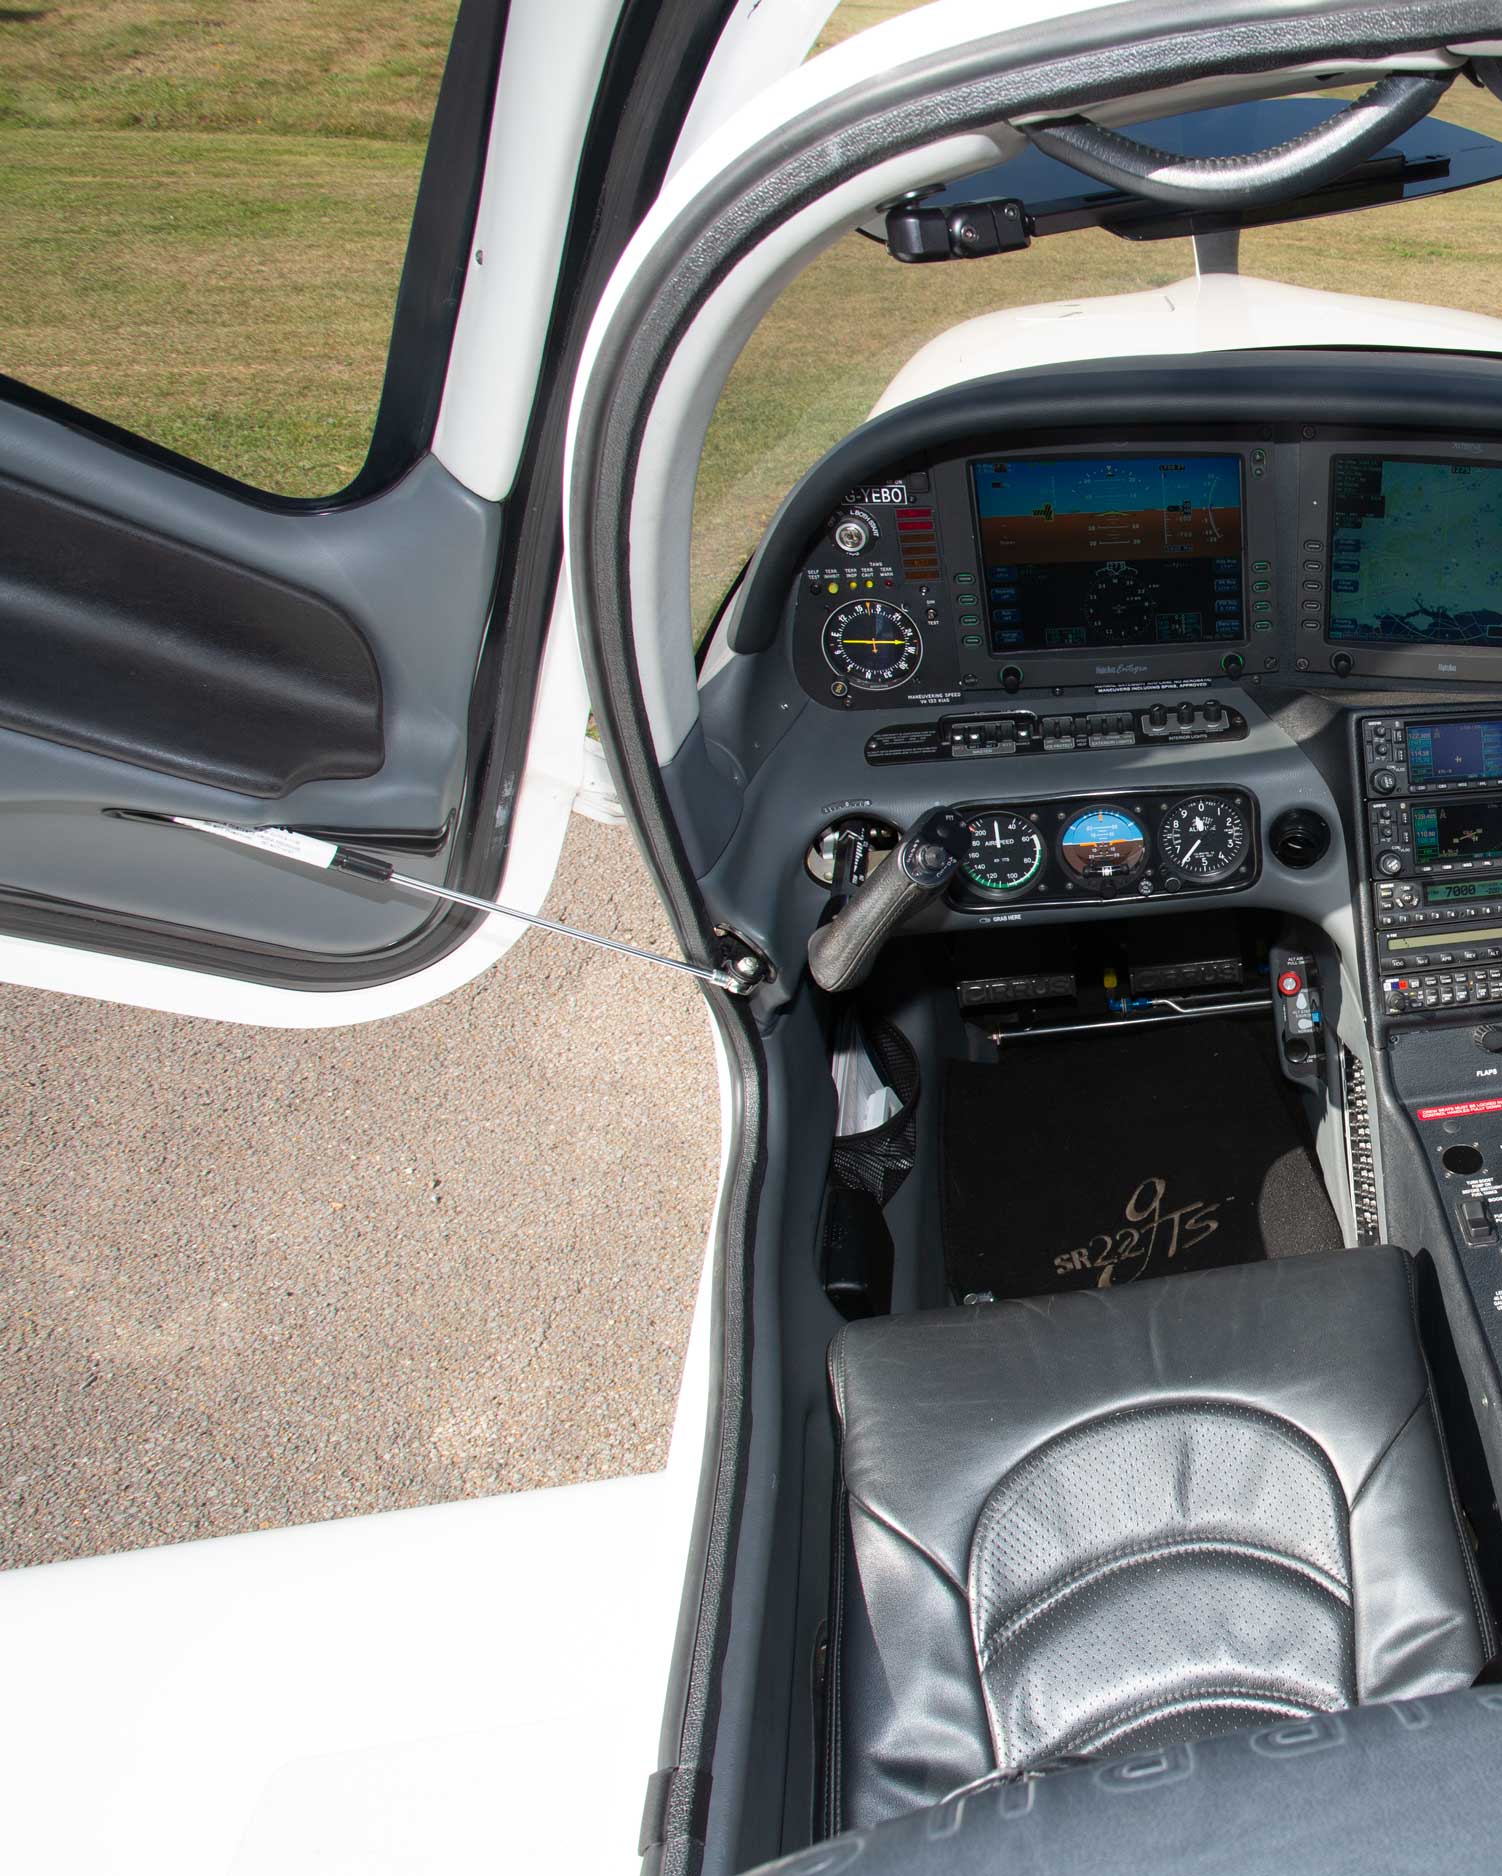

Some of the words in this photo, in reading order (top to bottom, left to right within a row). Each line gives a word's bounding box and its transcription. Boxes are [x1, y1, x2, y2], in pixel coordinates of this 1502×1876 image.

[845, 487, 902, 503] G-YEBO
[1445, 885, 1476, 897] 7000
[1476, 1068, 1498, 1077] FLAPS
